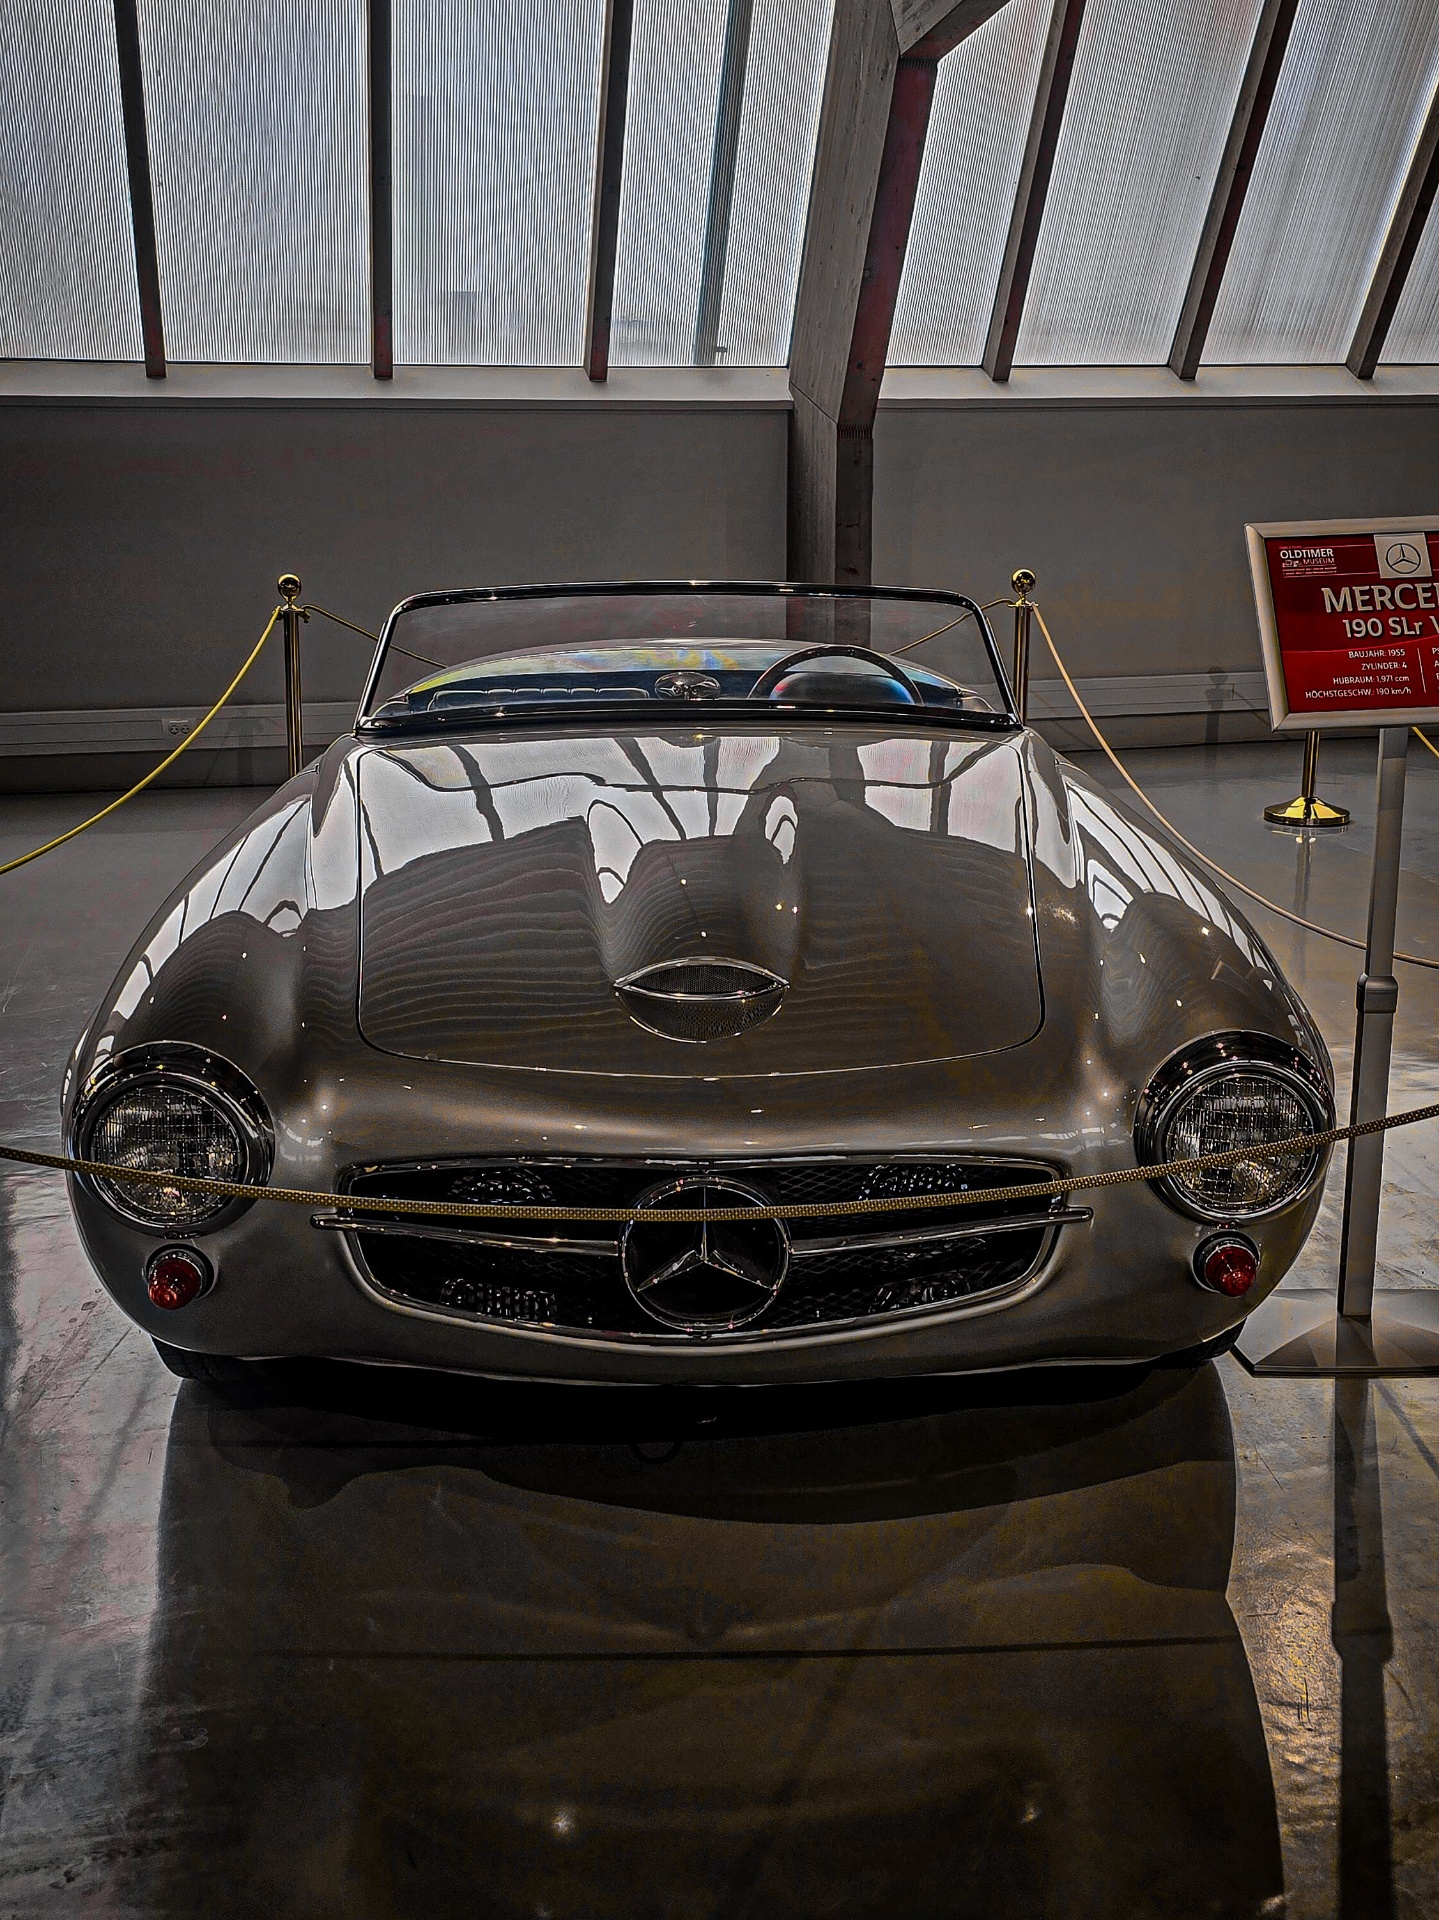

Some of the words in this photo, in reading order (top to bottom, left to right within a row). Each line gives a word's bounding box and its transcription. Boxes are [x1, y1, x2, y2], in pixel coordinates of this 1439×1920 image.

[1280, 548, 1334, 559] OLDTIMER
[1303, 557, 1335, 565] MUSEUM
[1342, 617, 1383, 638] 190
[1388, 616, 1423, 636] SLr
[1348, 650, 1387, 659] BAUJAHR:
[1388, 648, 1406, 657] 1955
[1361, 662, 1401, 671] ZYLINDER:
[1402, 661, 1408, 669] 4
[1333, 675, 1376, 685] HUBRAUM:
[1394, 674, 1410, 682] ccm
[1376, 686, 1390, 696] 190
[1391, 686, 1412, 695] km/h
